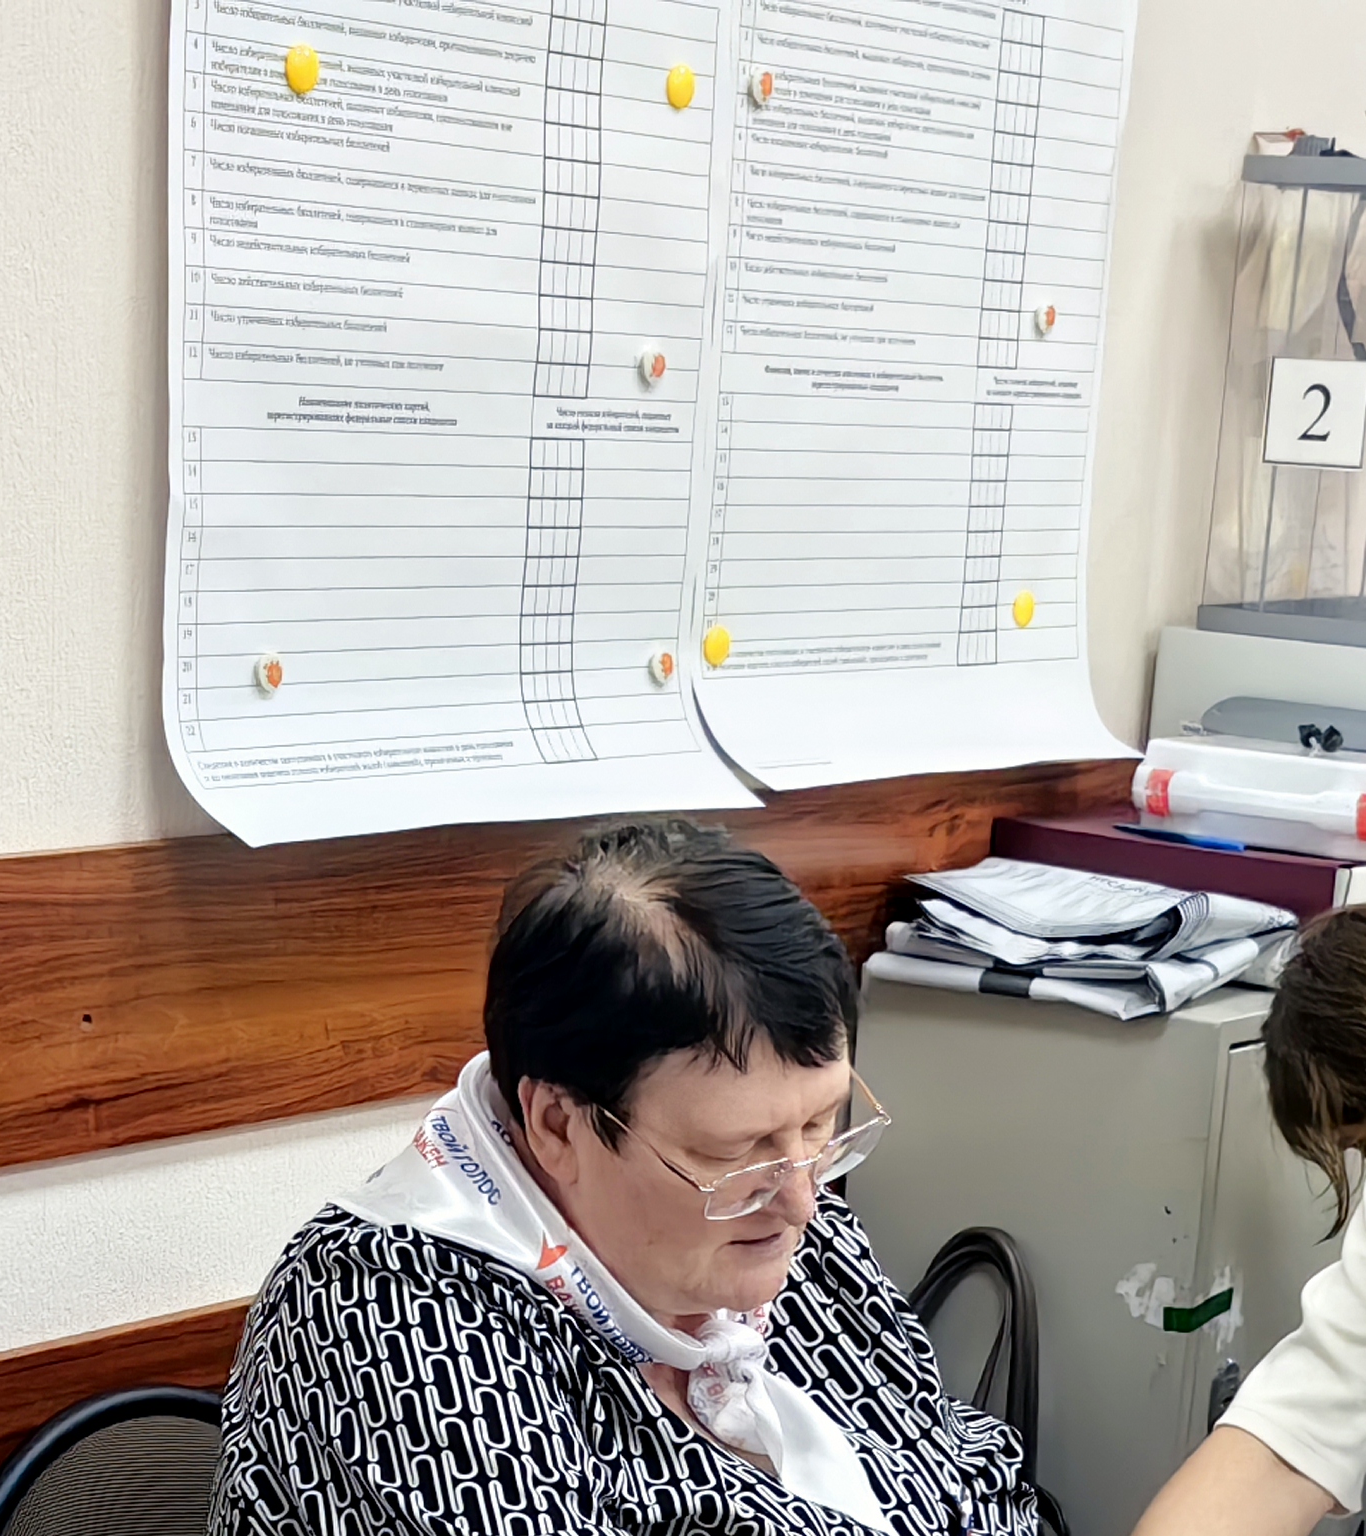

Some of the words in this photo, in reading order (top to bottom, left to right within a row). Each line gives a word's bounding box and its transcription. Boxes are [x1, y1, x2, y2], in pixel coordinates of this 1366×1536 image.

[1299, 383, 1332, 443] 2
[430, 1115, 470, 1155] ТВОЙ
[452, 1154, 503, 1206] ГОЛОС
